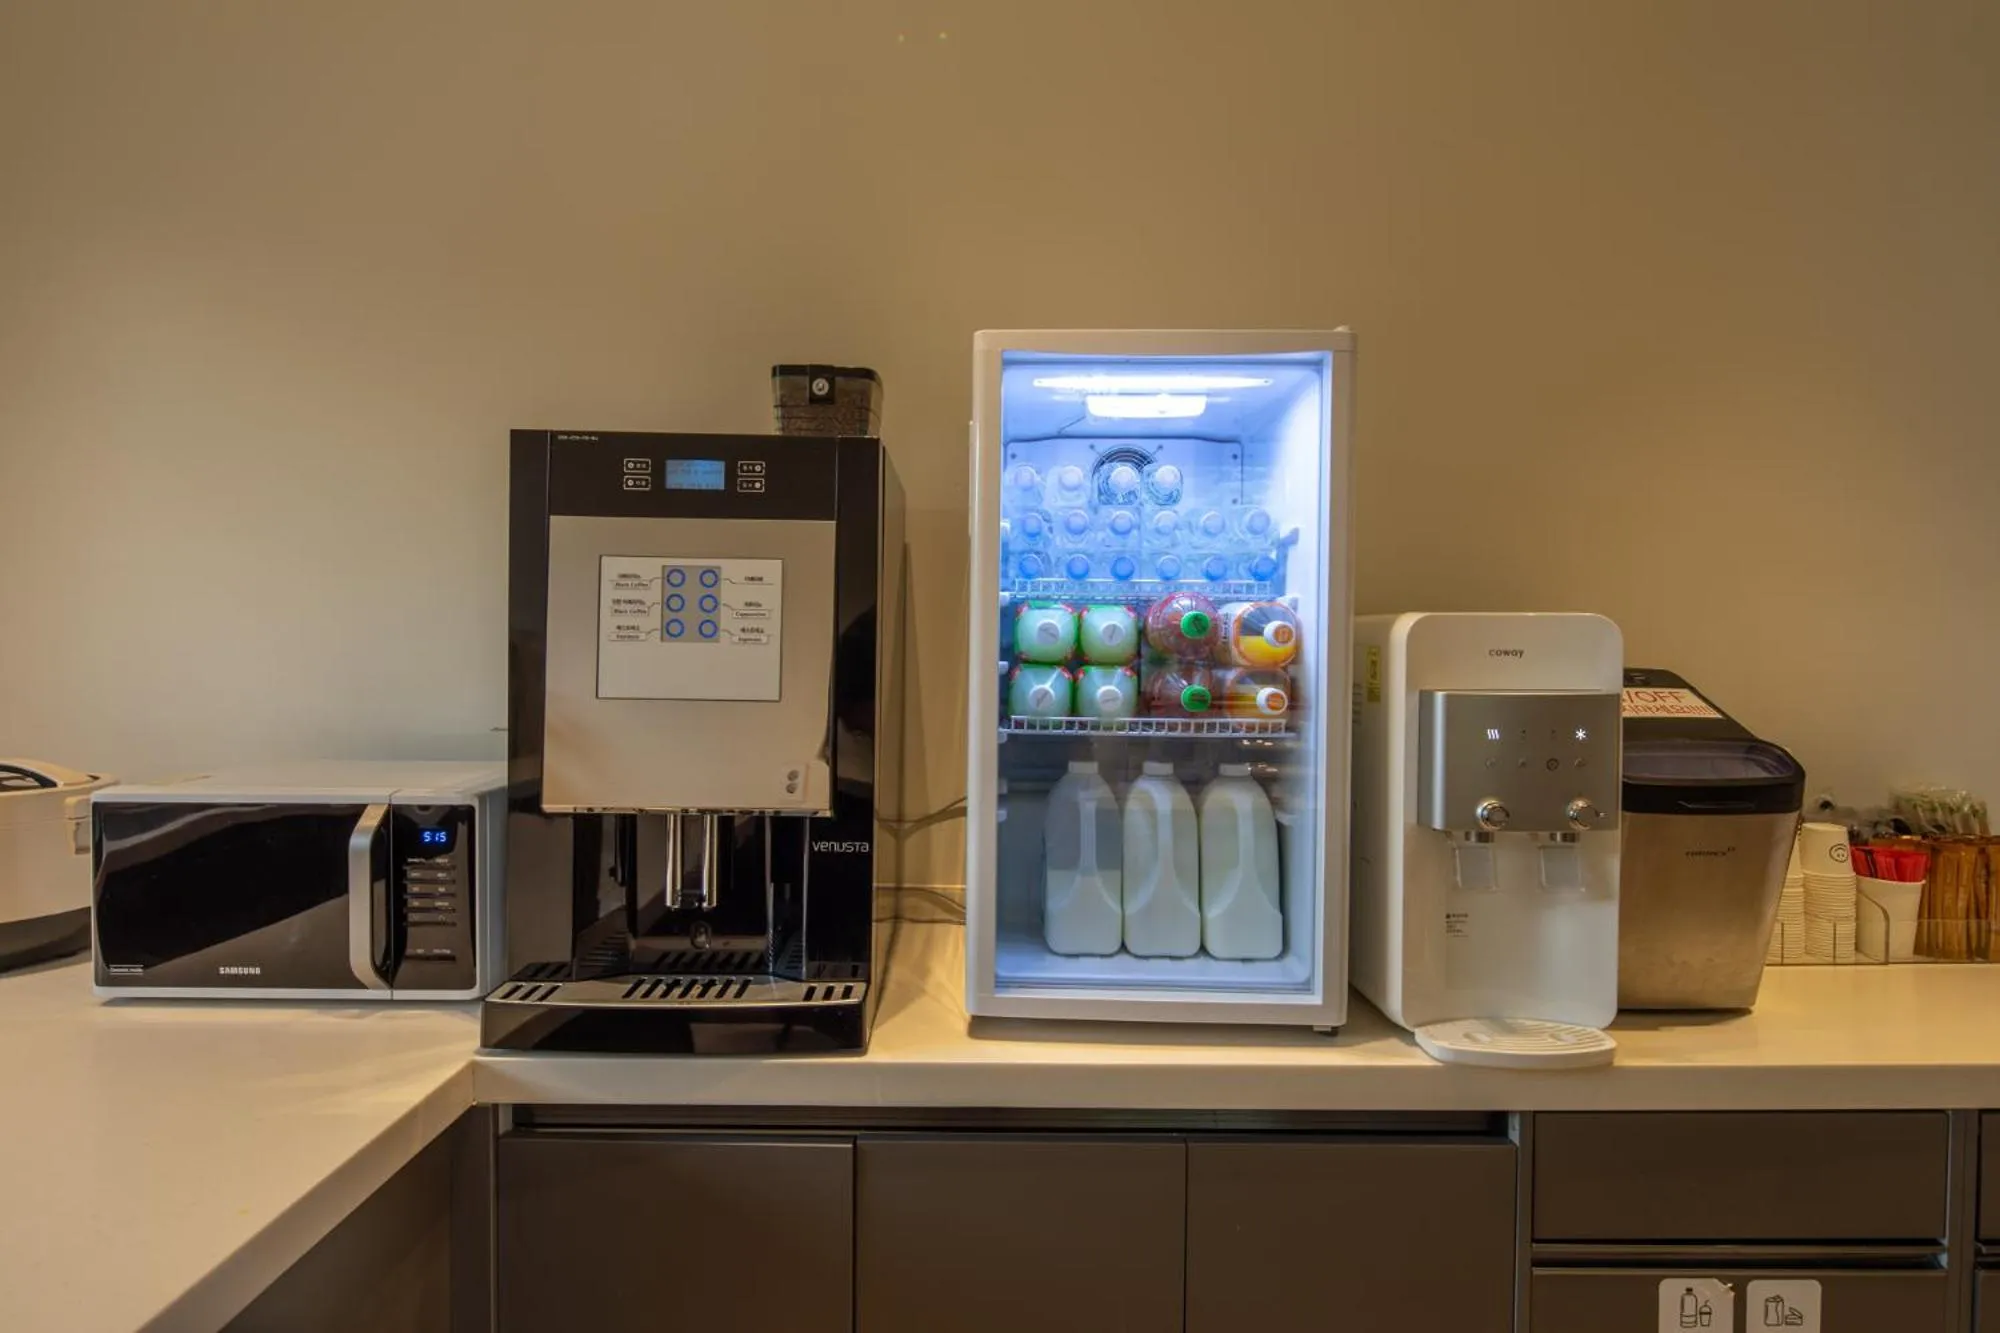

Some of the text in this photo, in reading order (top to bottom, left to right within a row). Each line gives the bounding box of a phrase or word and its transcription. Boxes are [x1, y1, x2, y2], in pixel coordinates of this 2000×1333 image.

[1488, 648, 1525, 659] coway
[1622, 690, 1685, 704] /OFF
[218, 966, 262, 975] SAMSUNG
